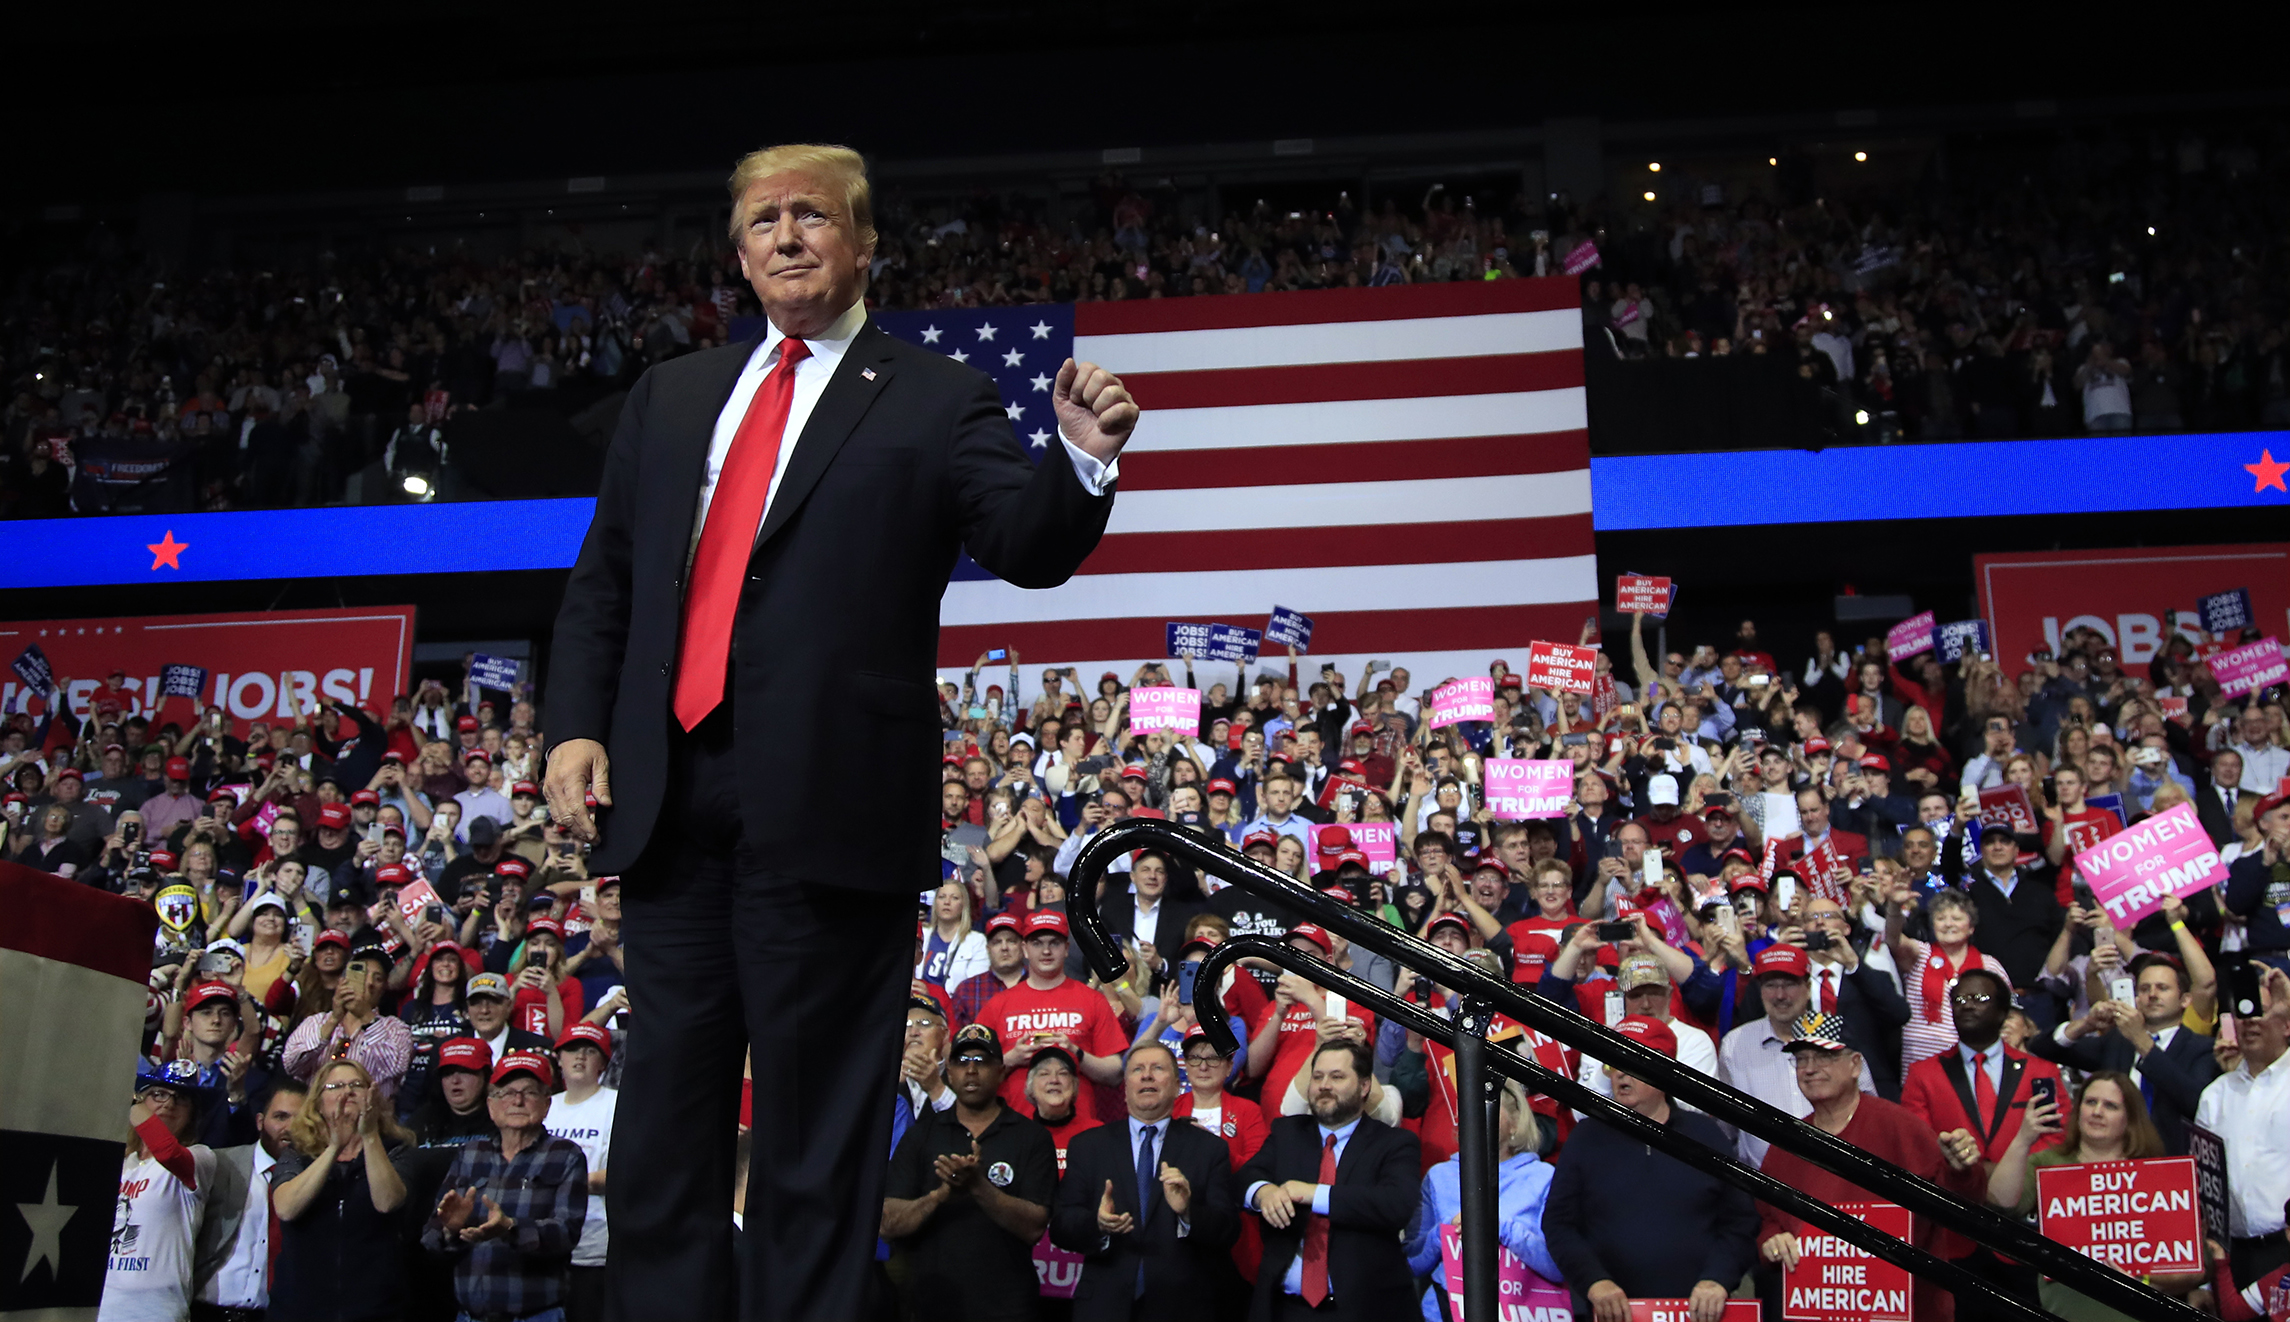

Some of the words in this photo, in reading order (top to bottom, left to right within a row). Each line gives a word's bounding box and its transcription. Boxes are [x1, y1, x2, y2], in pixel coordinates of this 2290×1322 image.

[1566, 252, 1599, 275] TRUMP
[1620, 586, 1668, 594] AMERICAN
[1620, 602, 1666, 610] AMERICAN
[2206, 591, 2240, 610] JOBS!
[1289, 613, 1303, 623] BUY
[2208, 603, 2243, 620] JOBS!
[1273, 615, 1311, 637] AMERICAN
[1888, 614, 1933, 637] WOMEN
[2211, 614, 2246, 632] JOBS!
[1174, 625, 1208, 637] JOBS!
[1228, 629, 1245, 637] BUY
[1284, 627, 1301, 639] HIRE
[1174, 636, 1208, 647] JOBS!
[1212, 633, 1258, 647] AMERICAN
[1268, 630, 1307, 651] AMERICAN
[1888, 635, 1933, 658] TRUM
[1174, 646, 1207, 658] JOBS!
[1210, 649, 1256, 661] AMERICAN
[1225, 644, 1244, 653] HIRE
[1552, 647, 1573, 658] BUY
[2213, 640, 2278, 670] WOMEN
[473, 661, 516, 675] AMERICAN
[1532, 654, 1593, 671] AMERICAN
[14, 663, 47, 696] AMERICAN
[167, 666, 201, 679] JOBS!
[1548, 667, 1573, 678] HIRE
[2221, 664, 2288, 694] TRUMP
[165, 675, 199, 687] JOBS!
[470, 675, 513, 689] AMERICAN
[1530, 675, 1591, 690] AMERICAN
[164, 684, 197, 696] JOBS!
[198, 667, 374, 721] JOBS!
[1435, 680, 1491, 701] WOMEN
[1133, 691, 1198, 705] WOMEN
[1452, 696, 1468, 705] FOR
[1432, 704, 1493, 723] TRUMP
[1131, 715, 1199, 730] TRUMP
[1489, 764, 1570, 779] WOMEN
[1518, 785, 1539, 793] FOR
[1486, 795, 1571, 813] TRUMP
[2082, 811, 2196, 876] WOMEN
[2134, 854, 2166, 876] FOR
[2103, 851, 2219, 919] TRUMP
[1255, 919, 1277, 929] YOU
[1005, 1012, 1082, 1032] TRUMP
[1005, 1031, 1022, 1039] KEEP
[2090, 1171, 2137, 1192] BUY
[2197, 1167, 2223, 1204] OBS!
[2047, 1190, 2190, 1218] AMERICAN
[2091, 1220, 2145, 1241] HIRE
[117, 1257, 150, 1271] FIRST
[1823, 1265, 1867, 1285] HIRE
[1500, 1280, 1523, 1296] OR
[1789, 1288, 1906, 1312] AMERICAN
